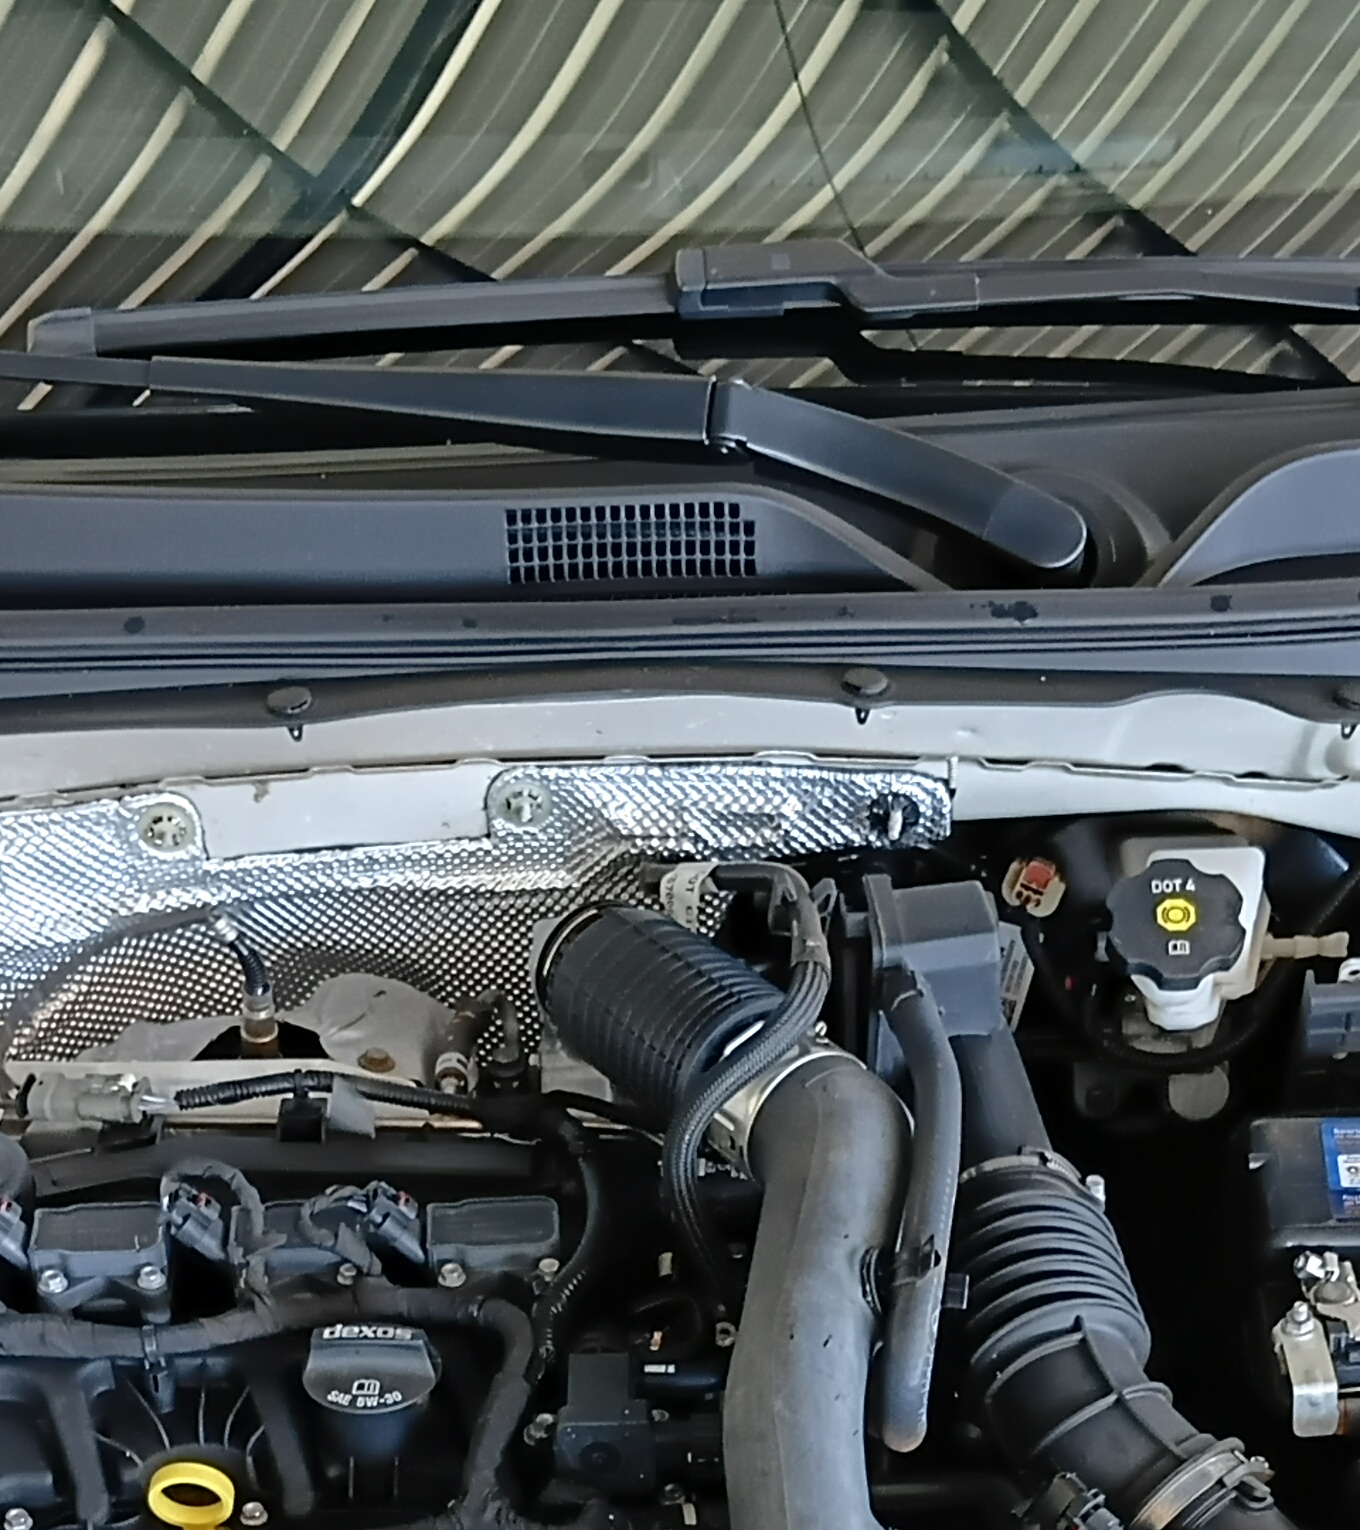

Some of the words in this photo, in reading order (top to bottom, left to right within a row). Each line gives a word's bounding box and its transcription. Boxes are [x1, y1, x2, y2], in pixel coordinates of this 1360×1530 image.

[1151, 880, 1182, 893] DOT
[1185, 878, 1196, 892] 4
[323, 1324, 412, 1340] dexos
[327, 1390, 353, 1406] SAE
